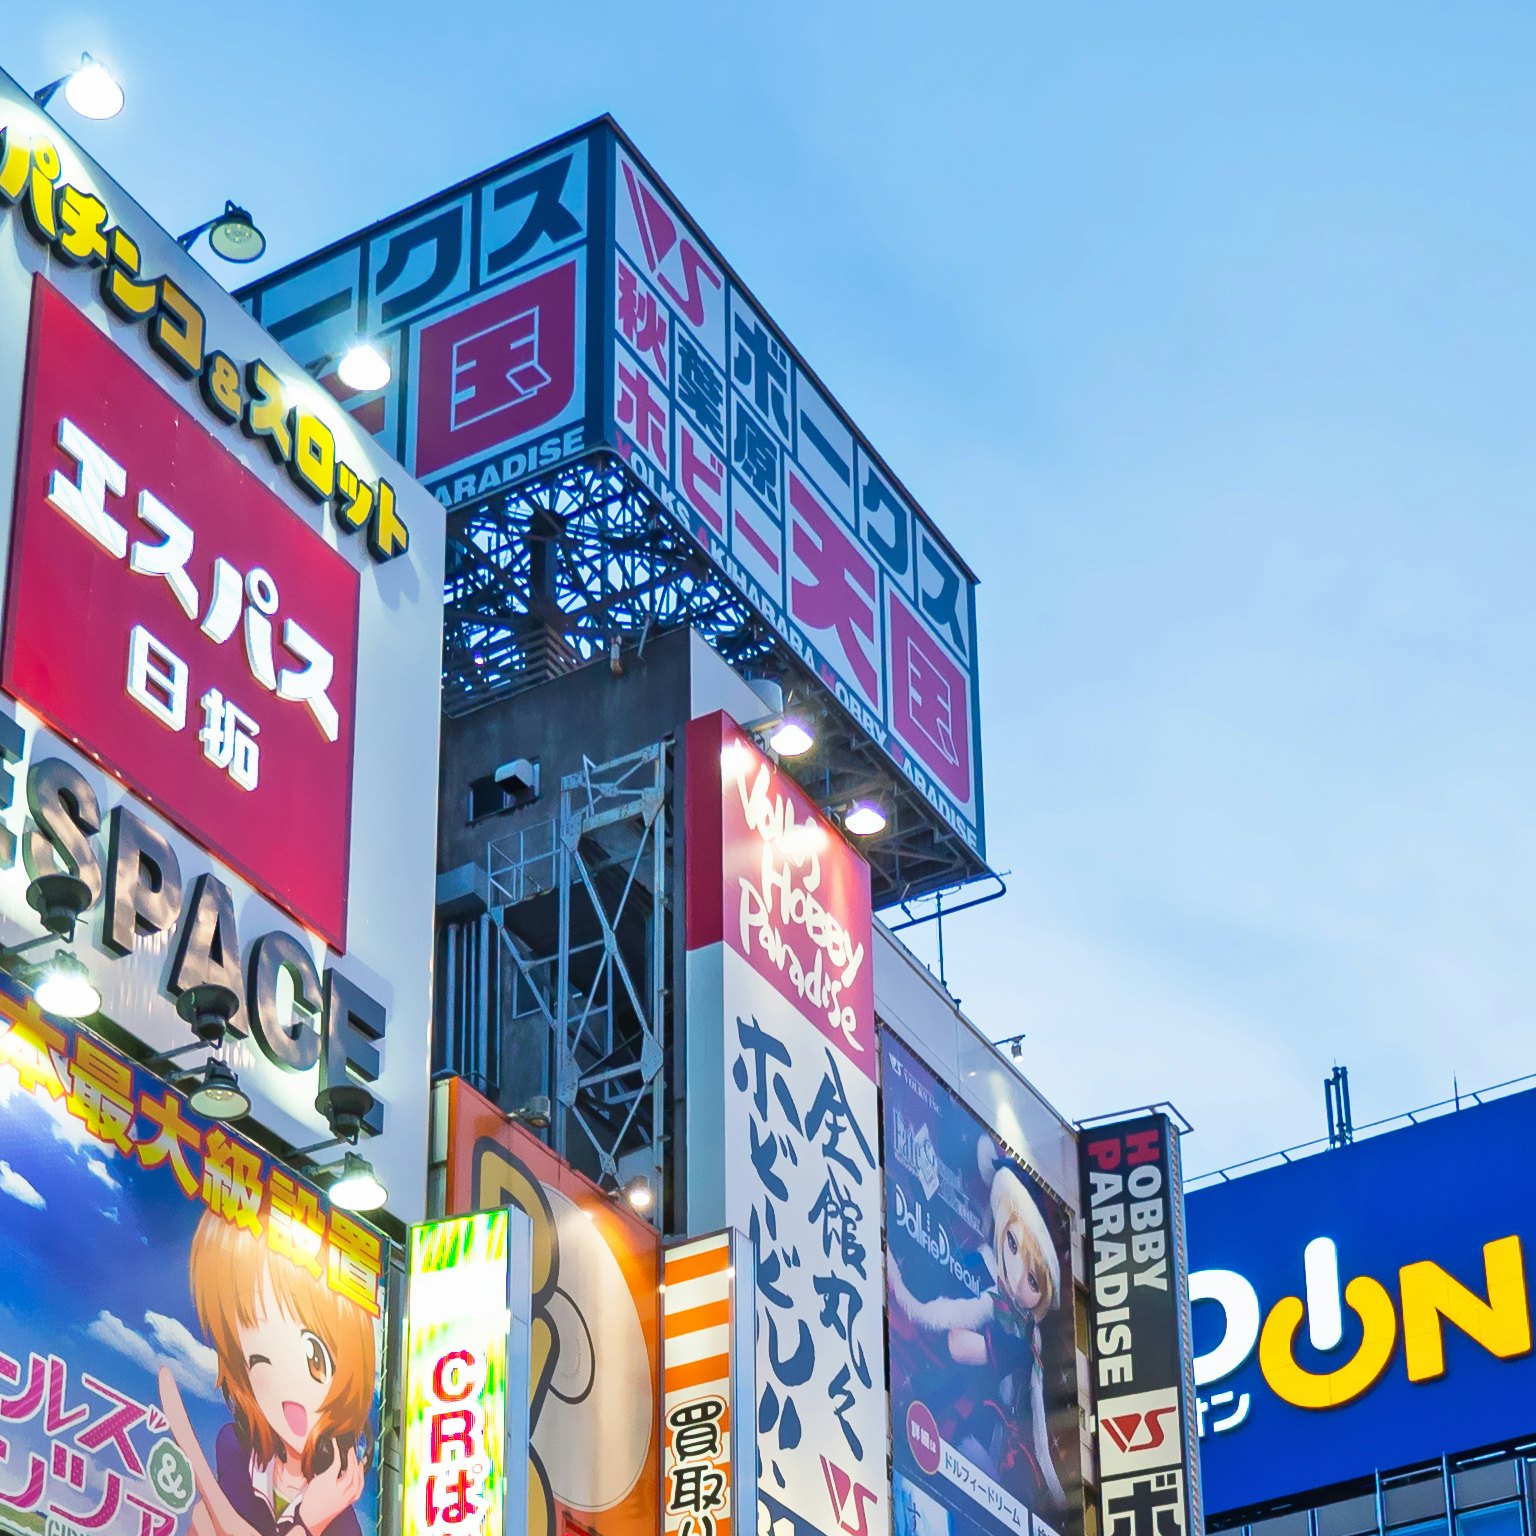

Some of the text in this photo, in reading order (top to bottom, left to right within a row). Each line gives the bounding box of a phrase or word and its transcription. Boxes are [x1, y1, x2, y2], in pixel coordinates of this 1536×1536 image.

[617, 365, 780, 578] ホビー
[619, 258, 780, 509] 秋葉原
[734, 312, 961, 637] ボークス
[48, 418, 339, 741] エスパス
[619, 435, 978, 852] VOLKS AKIHABARA HOBBY PARADISE
[126, 624, 261, 792] 日拓
[739, 877, 865, 1052] Paradise
[1087, 1137, 1134, 1388] PARADISE
[1126, 1129, 1168, 1293] HOBBY
[943, 1450, 1022, 1528] ドルフィードリーム
